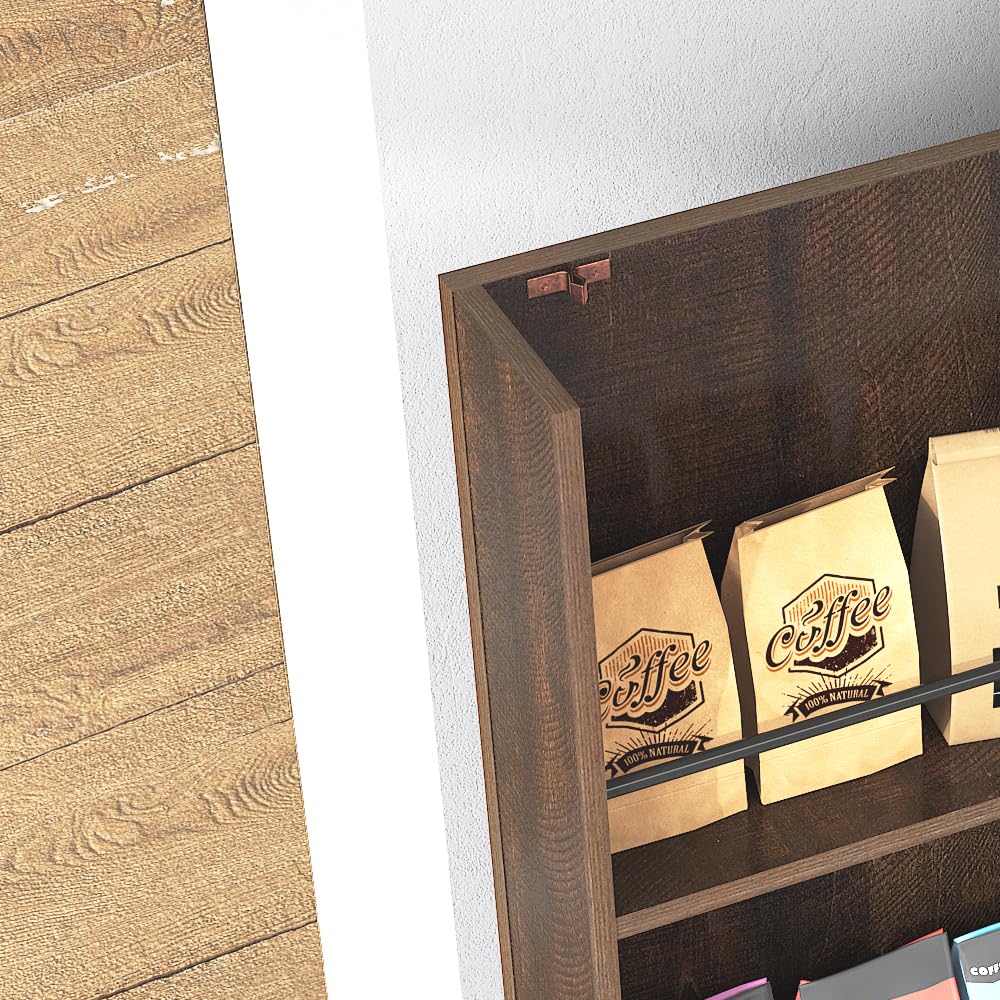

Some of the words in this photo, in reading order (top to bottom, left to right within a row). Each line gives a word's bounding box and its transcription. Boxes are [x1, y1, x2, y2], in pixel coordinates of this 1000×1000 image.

[765, 586, 893, 672] Coffee
[804, 695, 829, 711] 100%
[829, 688, 869, 702] NATURAL
[623, 751, 648, 767] 100%
[649, 744, 690, 757] NATURAL
